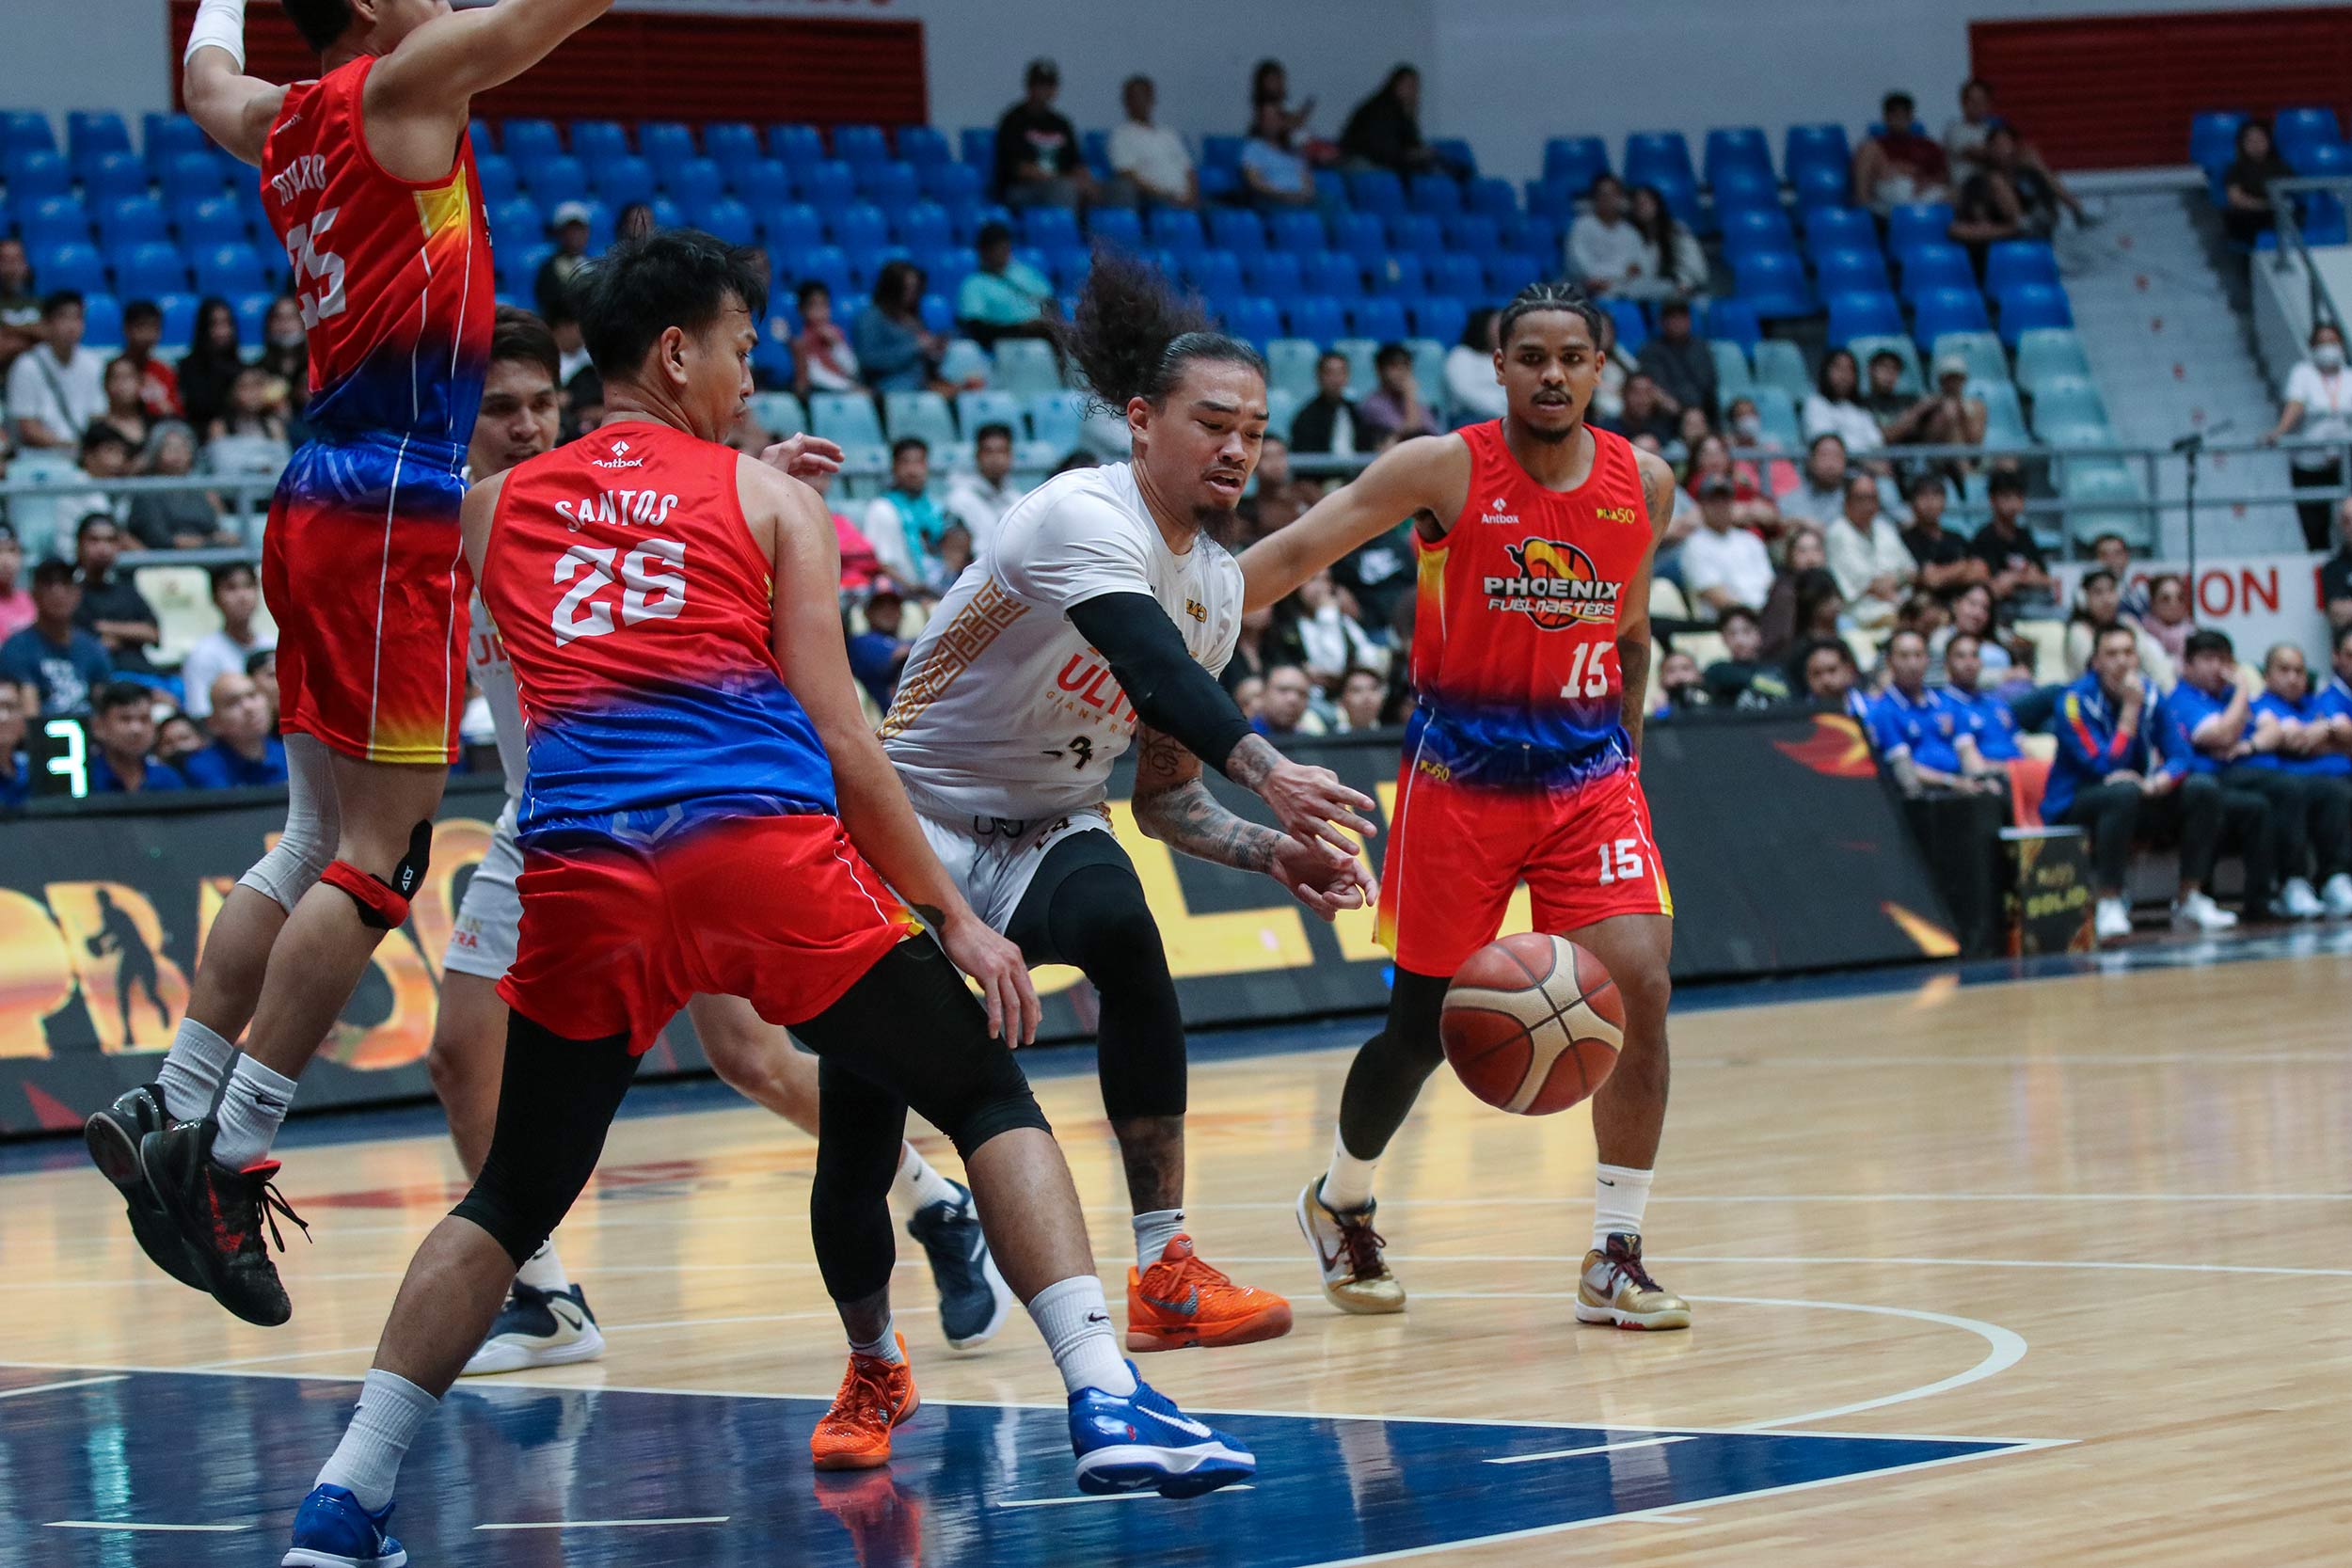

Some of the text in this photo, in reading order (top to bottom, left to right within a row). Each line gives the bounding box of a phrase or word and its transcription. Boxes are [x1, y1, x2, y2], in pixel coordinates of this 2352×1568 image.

[286, 207, 346, 330] 25
[592, 457, 643, 468] Antbox
[554, 489, 678, 532] SANTOS
[1481, 513, 1519, 525] Antbox
[551, 538, 687, 648] 26
[1484, 577, 1622, 600] PHOENIX
[1560, 641, 1614, 698] 15
[1598, 838, 1644, 885] 15
